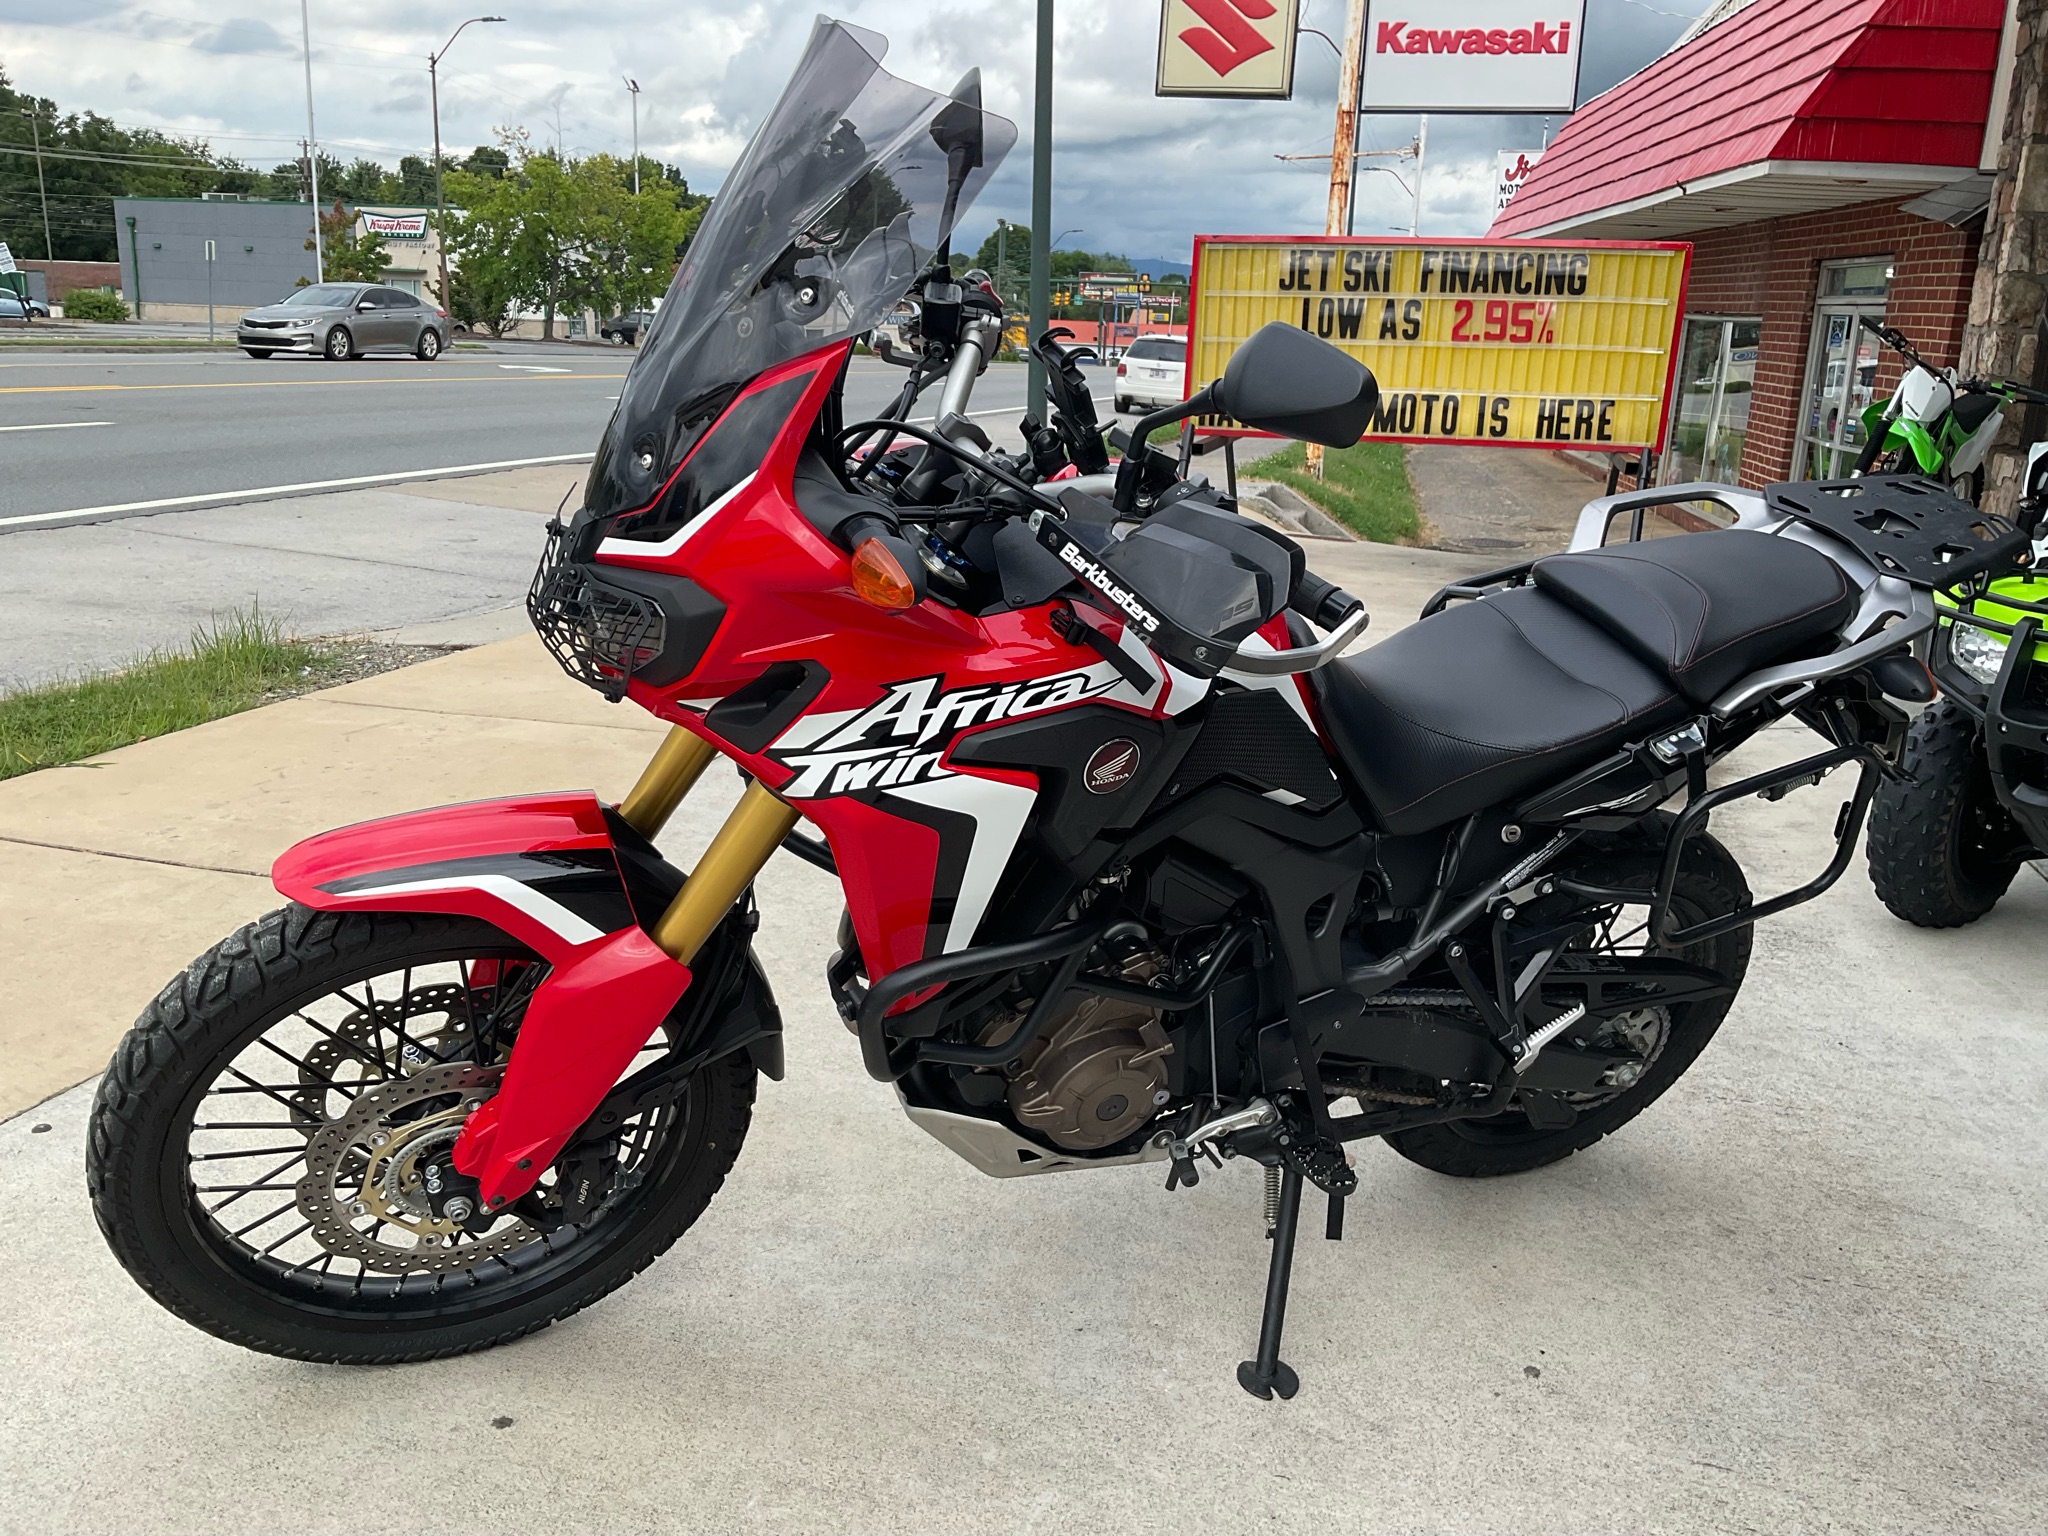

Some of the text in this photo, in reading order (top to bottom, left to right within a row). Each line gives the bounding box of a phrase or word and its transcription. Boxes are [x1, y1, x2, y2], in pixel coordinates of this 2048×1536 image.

[1376, 21, 1571, 55] Kawasaki
[1499, 184, 1520, 195] MOT
[369, 219, 421, 231] Krispy Kreme
[1278, 249, 1590, 296] JET SKI FINANCING
[1301, 297, 1554, 344] LOW AS 2.95%
[1372, 393, 1616, 441] MOTO IS HERE
[1058, 541, 1161, 632] Barkbusters
[812, 675, 1124, 753] Africa
[781, 745, 956, 797] Twin
[1091, 772, 1130, 786] HONDA
